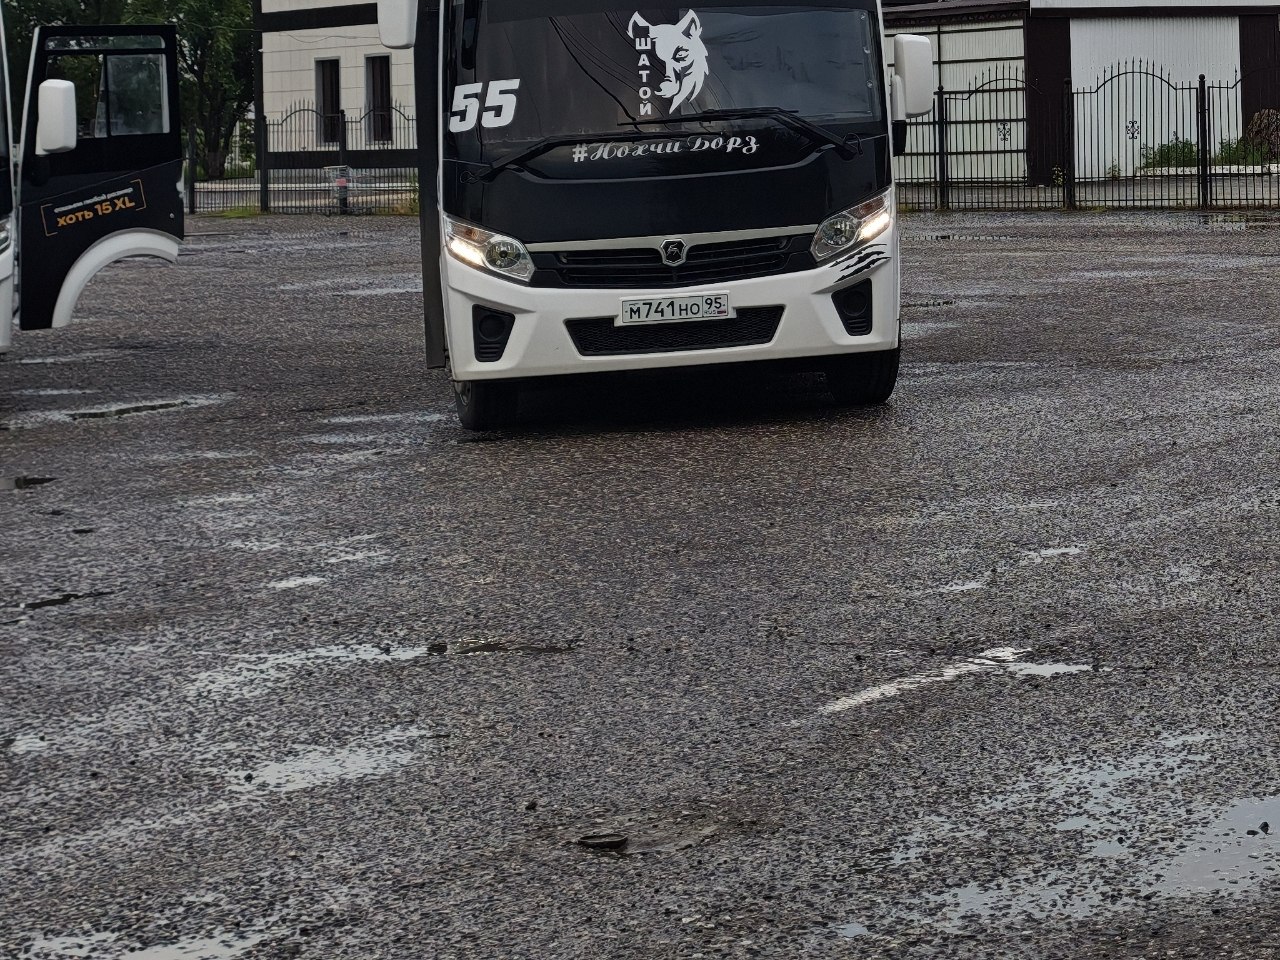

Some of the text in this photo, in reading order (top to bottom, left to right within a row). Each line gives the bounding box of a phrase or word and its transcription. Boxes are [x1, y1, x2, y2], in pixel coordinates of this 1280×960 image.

[635, 37, 652, 116] ШАТОЙ
[449, 78, 521, 133] 55
[94, 201, 113, 215] 15
[114, 196, 135, 210] XL
[704, 297, 722, 310] 95
